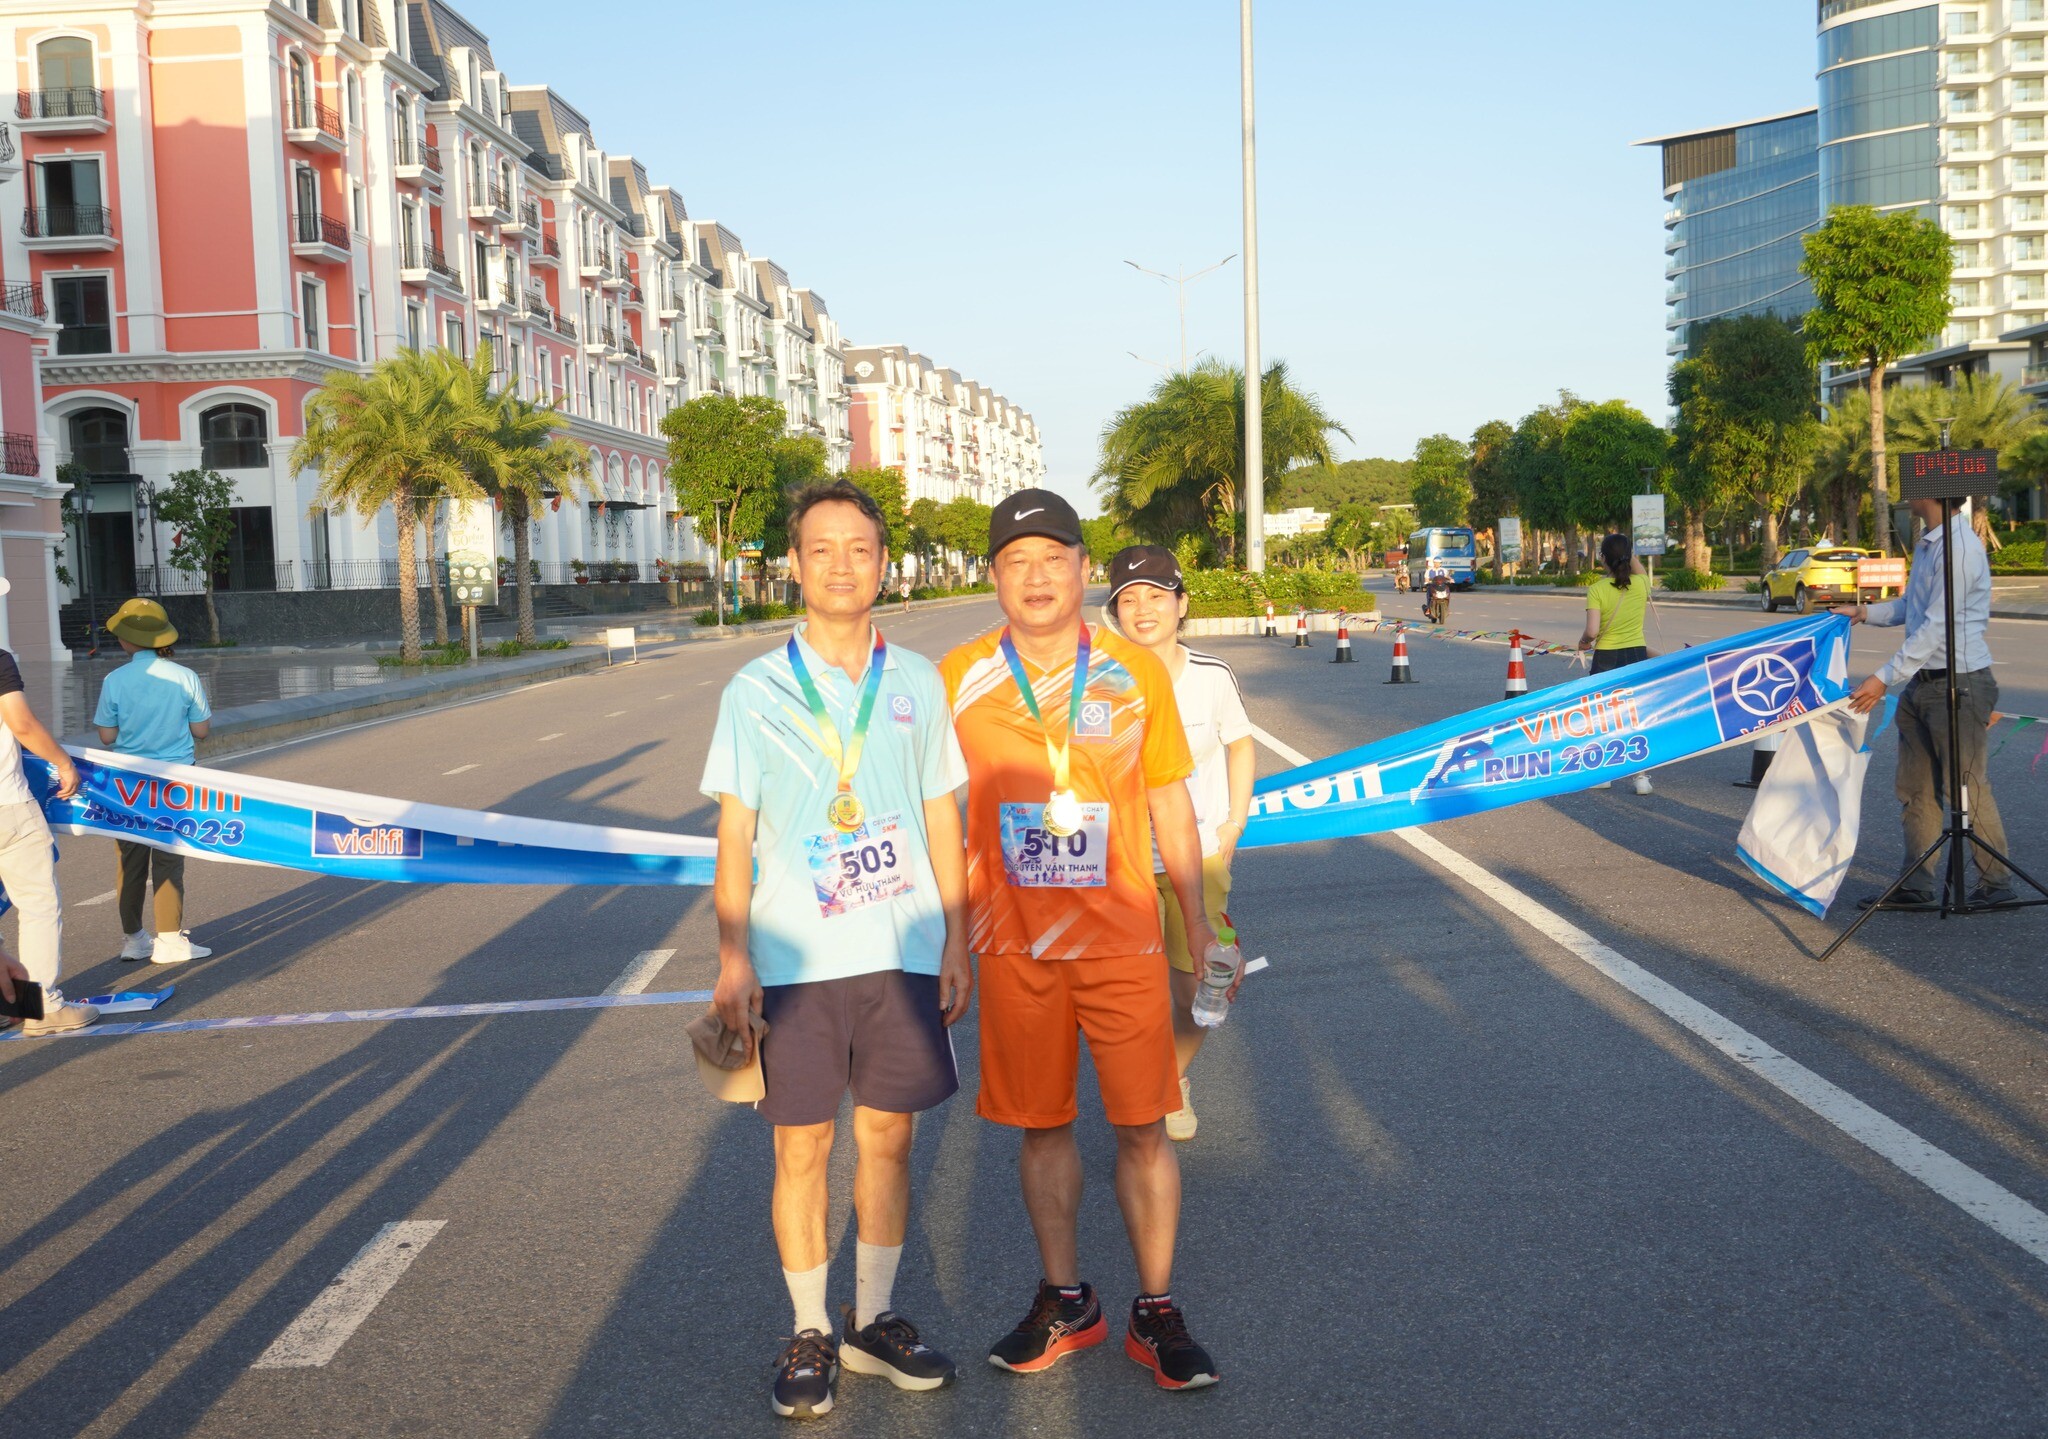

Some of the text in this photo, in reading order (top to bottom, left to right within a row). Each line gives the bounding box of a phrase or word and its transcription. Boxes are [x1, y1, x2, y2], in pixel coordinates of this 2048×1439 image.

[1516, 688, 1640, 744] vidifi
[1483, 734, 1650, 787] RUN 2023
[152, 815, 246, 847] 2023
[882, 823, 897, 833] 5KM
[1082, 814, 1096, 822] KM
[332, 827, 404, 855] vidifi
[1023, 828, 1087, 857] 510
[839, 840, 897, 880] 503
[1068, 863, 1098, 872] THANH
